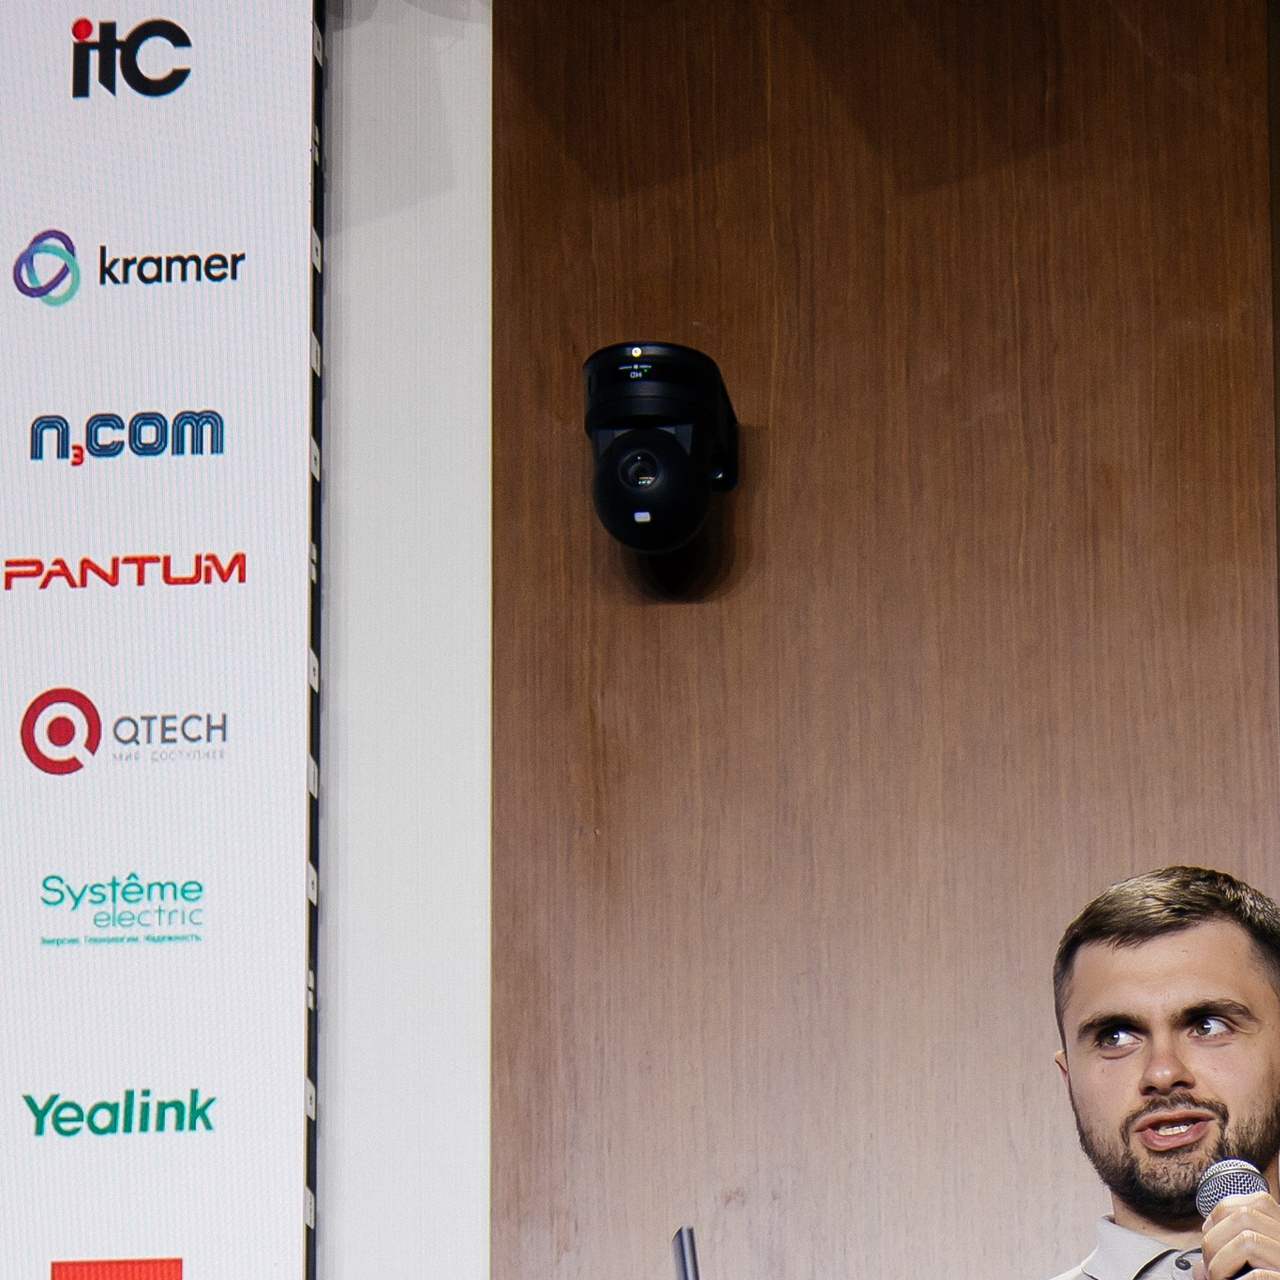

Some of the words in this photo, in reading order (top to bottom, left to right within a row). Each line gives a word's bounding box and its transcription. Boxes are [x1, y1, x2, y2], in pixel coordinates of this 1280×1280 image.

[99, 245, 246, 285] kramer
[4, 552, 246, 590] PANTUM
[113, 713, 227, 745] QTECH
[41, 872, 204, 911] Systême
[93, 903, 203, 928] electric
[22, 1088, 217, 1138] Yealink
